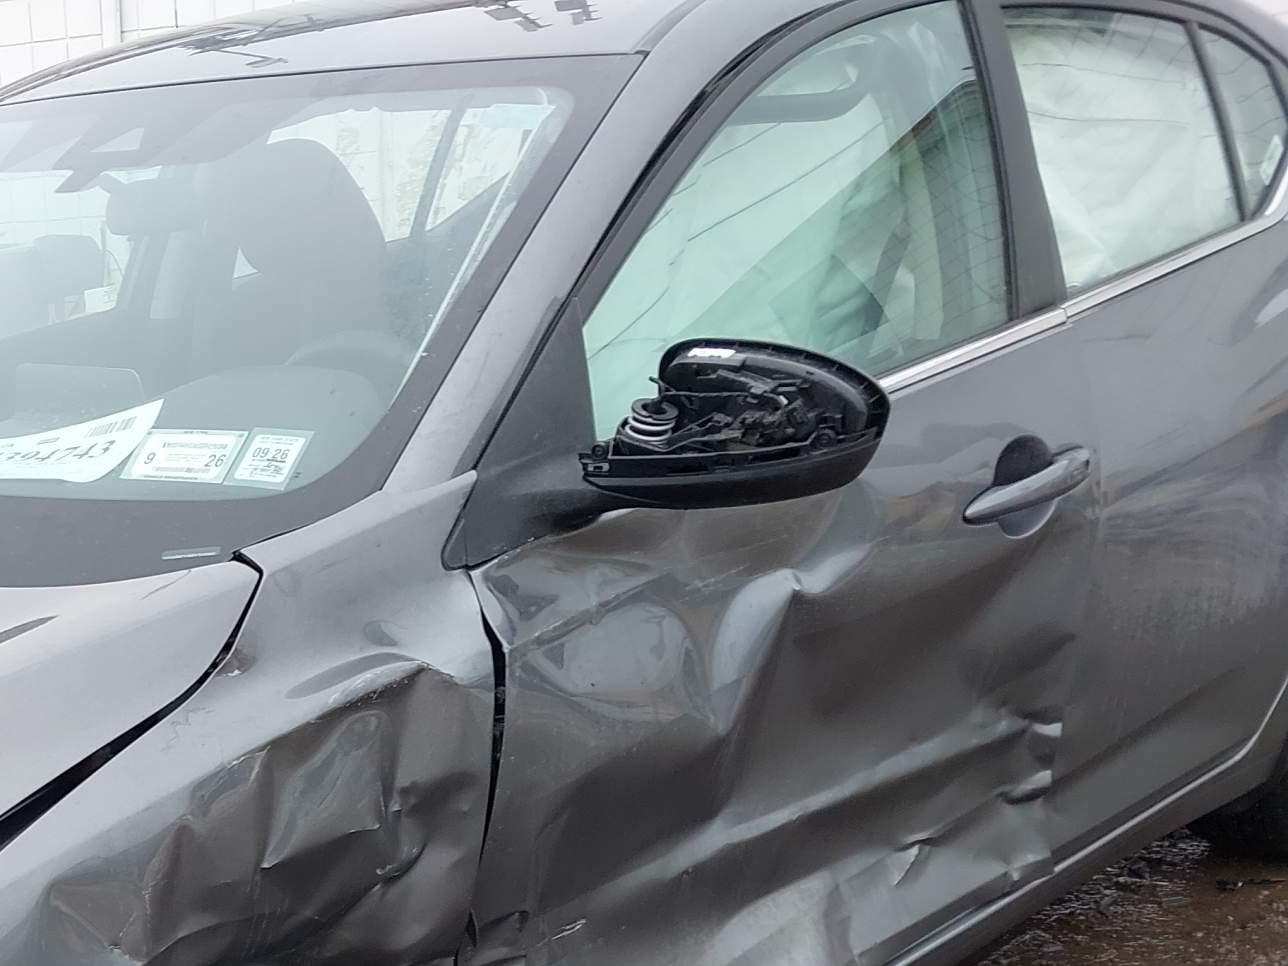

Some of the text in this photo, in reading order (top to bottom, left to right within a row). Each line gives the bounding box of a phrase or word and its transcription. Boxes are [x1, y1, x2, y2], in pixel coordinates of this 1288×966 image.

[143, 451, 157, 465] 9
[204, 454, 227, 467] 26
[252, 447, 290, 460] 09 26
